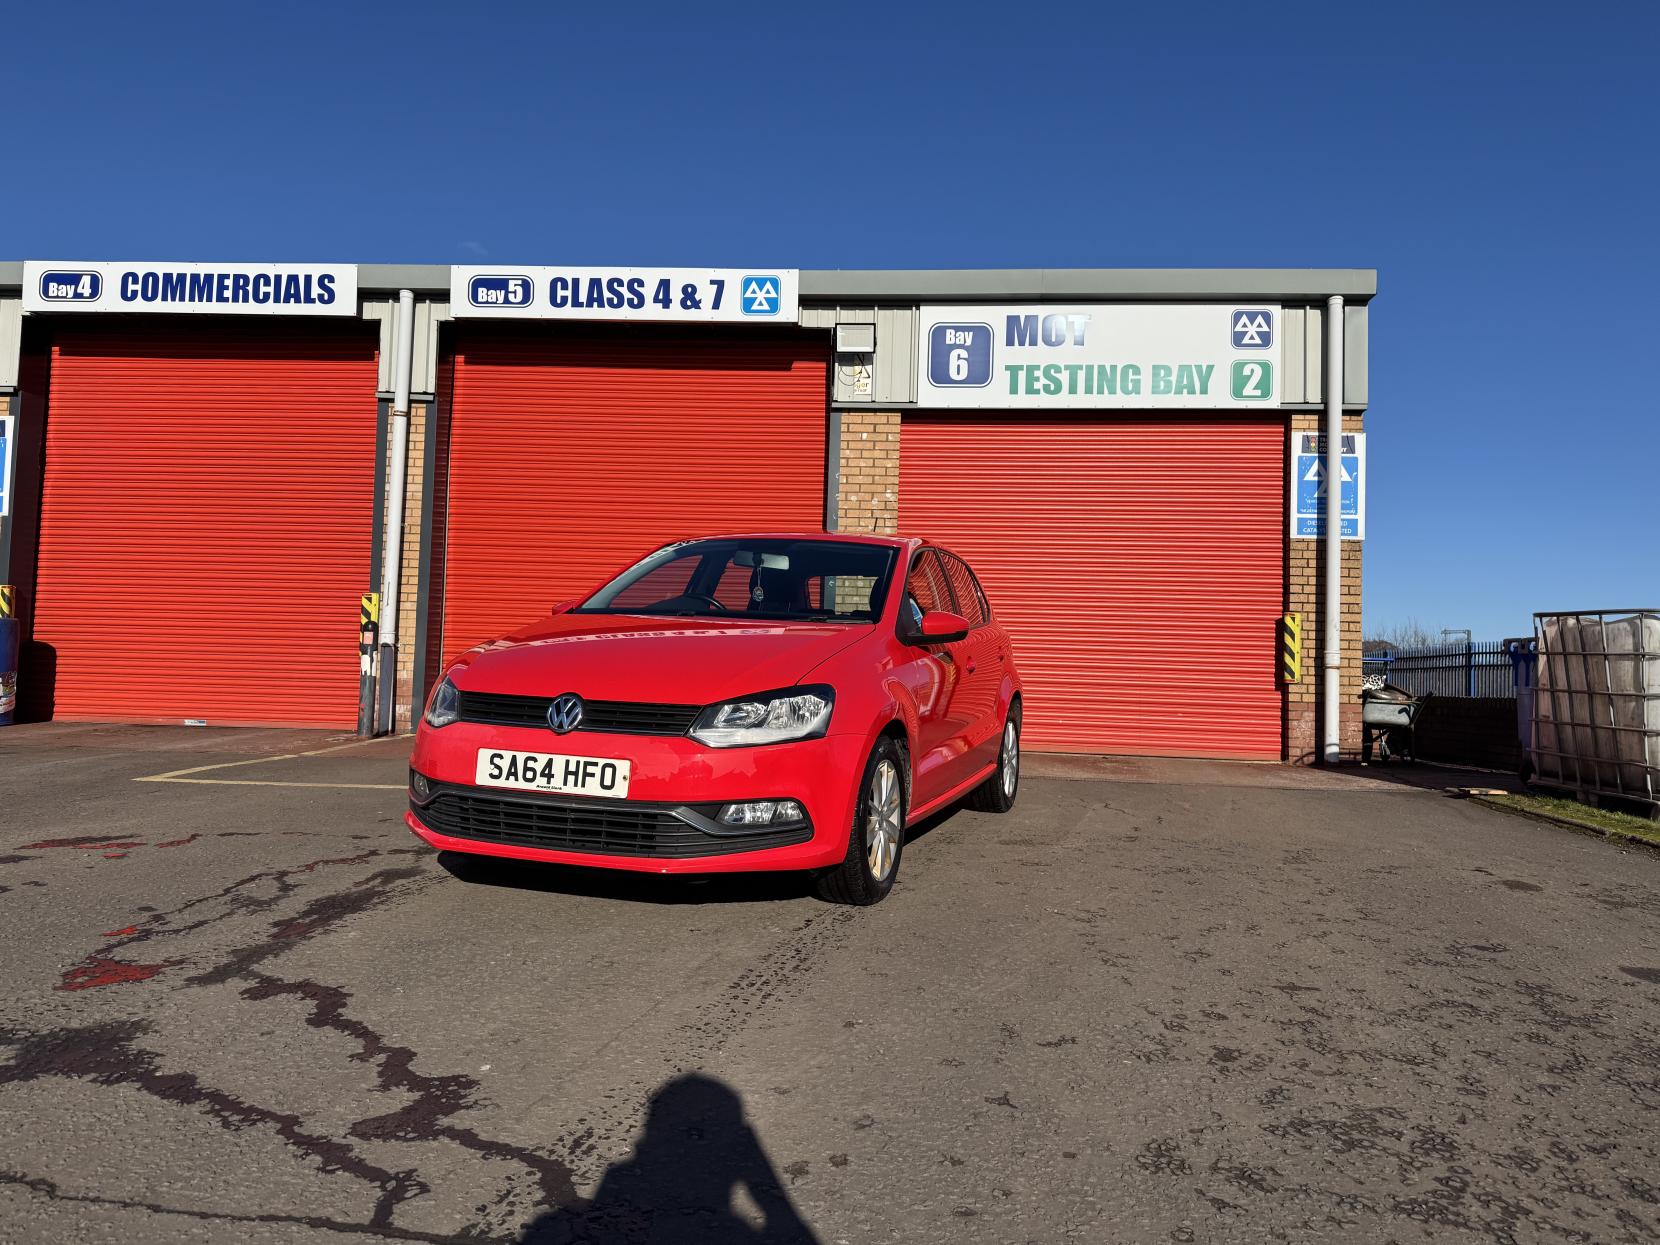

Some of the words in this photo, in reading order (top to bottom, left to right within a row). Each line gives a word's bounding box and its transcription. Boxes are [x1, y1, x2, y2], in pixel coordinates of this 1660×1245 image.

[48, 282, 75, 299] Bay
[77, 274, 92, 297] 4
[120, 271, 336, 305] COMMERCIALS
[477, 287, 505, 304] Bay
[508, 279, 524, 303] 5
[549, 276, 646, 310] CLASS
[652, 278, 673, 310] 4
[679, 283, 703, 311] &
[709, 279, 726, 311] 7
[945, 328, 974, 346] Bay
[1005, 313, 1093, 347] MOT
[948, 348, 969, 381] 6
[1004, 363, 1142, 396] TESTING
[1151, 364, 1216, 396] BAY
[1242, 362, 1263, 397] 2
[488, 752, 555, 785] SA64
[563, 758, 617, 790] HFO
